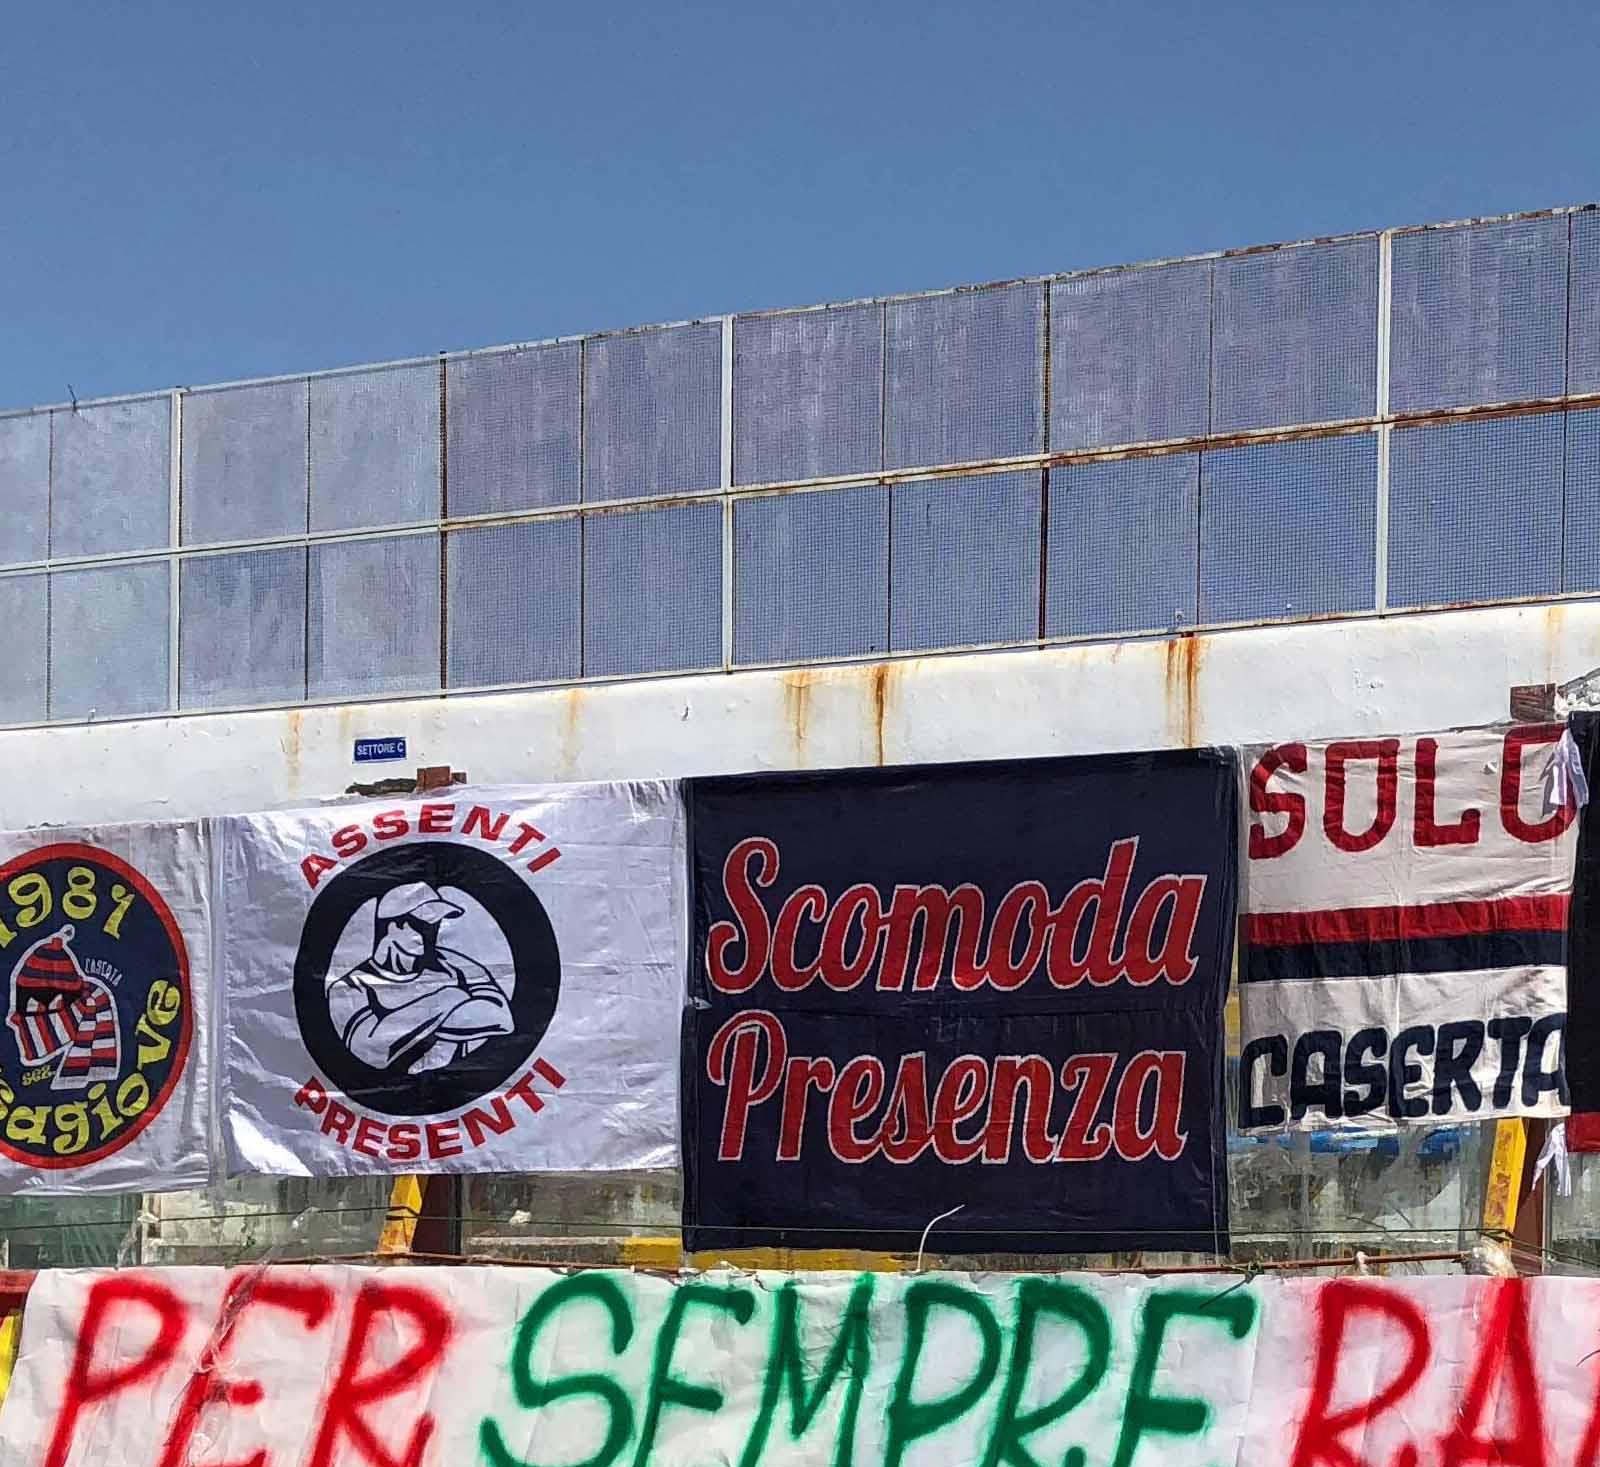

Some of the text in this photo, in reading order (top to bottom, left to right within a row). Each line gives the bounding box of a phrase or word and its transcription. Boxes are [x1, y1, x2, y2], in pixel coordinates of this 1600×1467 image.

[356, 742, 404, 756] SETTORE C
[1249, 721, 1580, 859] SOLO
[300, 803, 563, 889] ASSENTI
[708, 835, 1208, 994] Scomoda
[292, 1056, 567, 1160] PRESENTI
[707, 1008, 1190, 1165] Presenza
[1238, 1011, 1569, 1128] CASERTA
